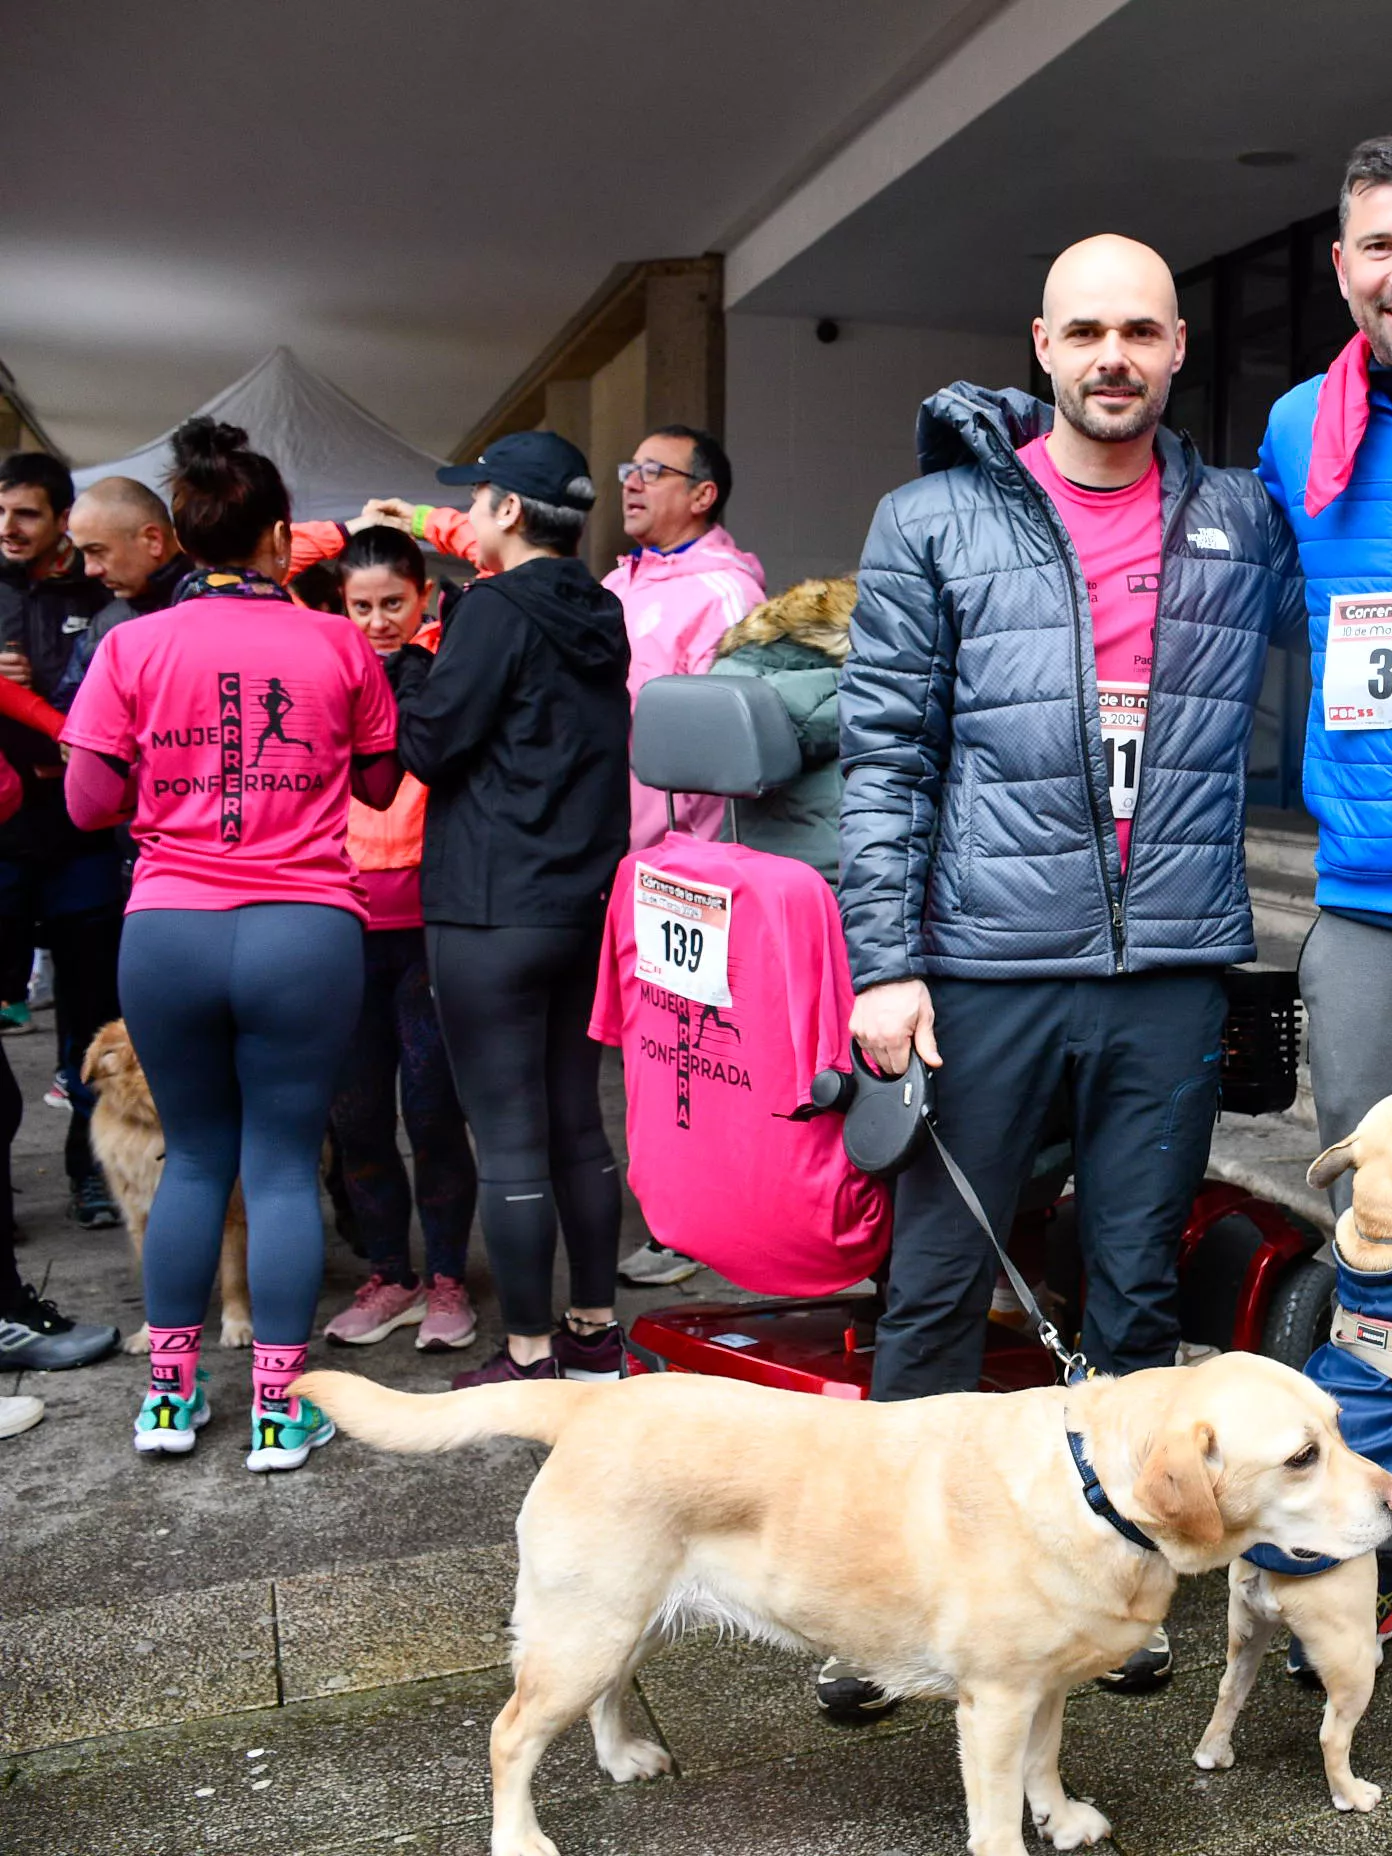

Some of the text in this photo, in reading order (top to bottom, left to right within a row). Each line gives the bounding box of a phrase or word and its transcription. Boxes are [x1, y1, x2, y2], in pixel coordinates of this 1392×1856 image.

[1343, 627, 1351, 636] 10
[1355, 625, 1367, 636] de
[1099, 693, 1119, 706] de
[1121, 694, 1136, 707] la
[1111, 714, 1140, 725] 2024
[153, 773, 326, 798] PONFERRADA
[661, 920, 704, 973] 139
[641, 1035, 752, 1092] PONFERRADA
